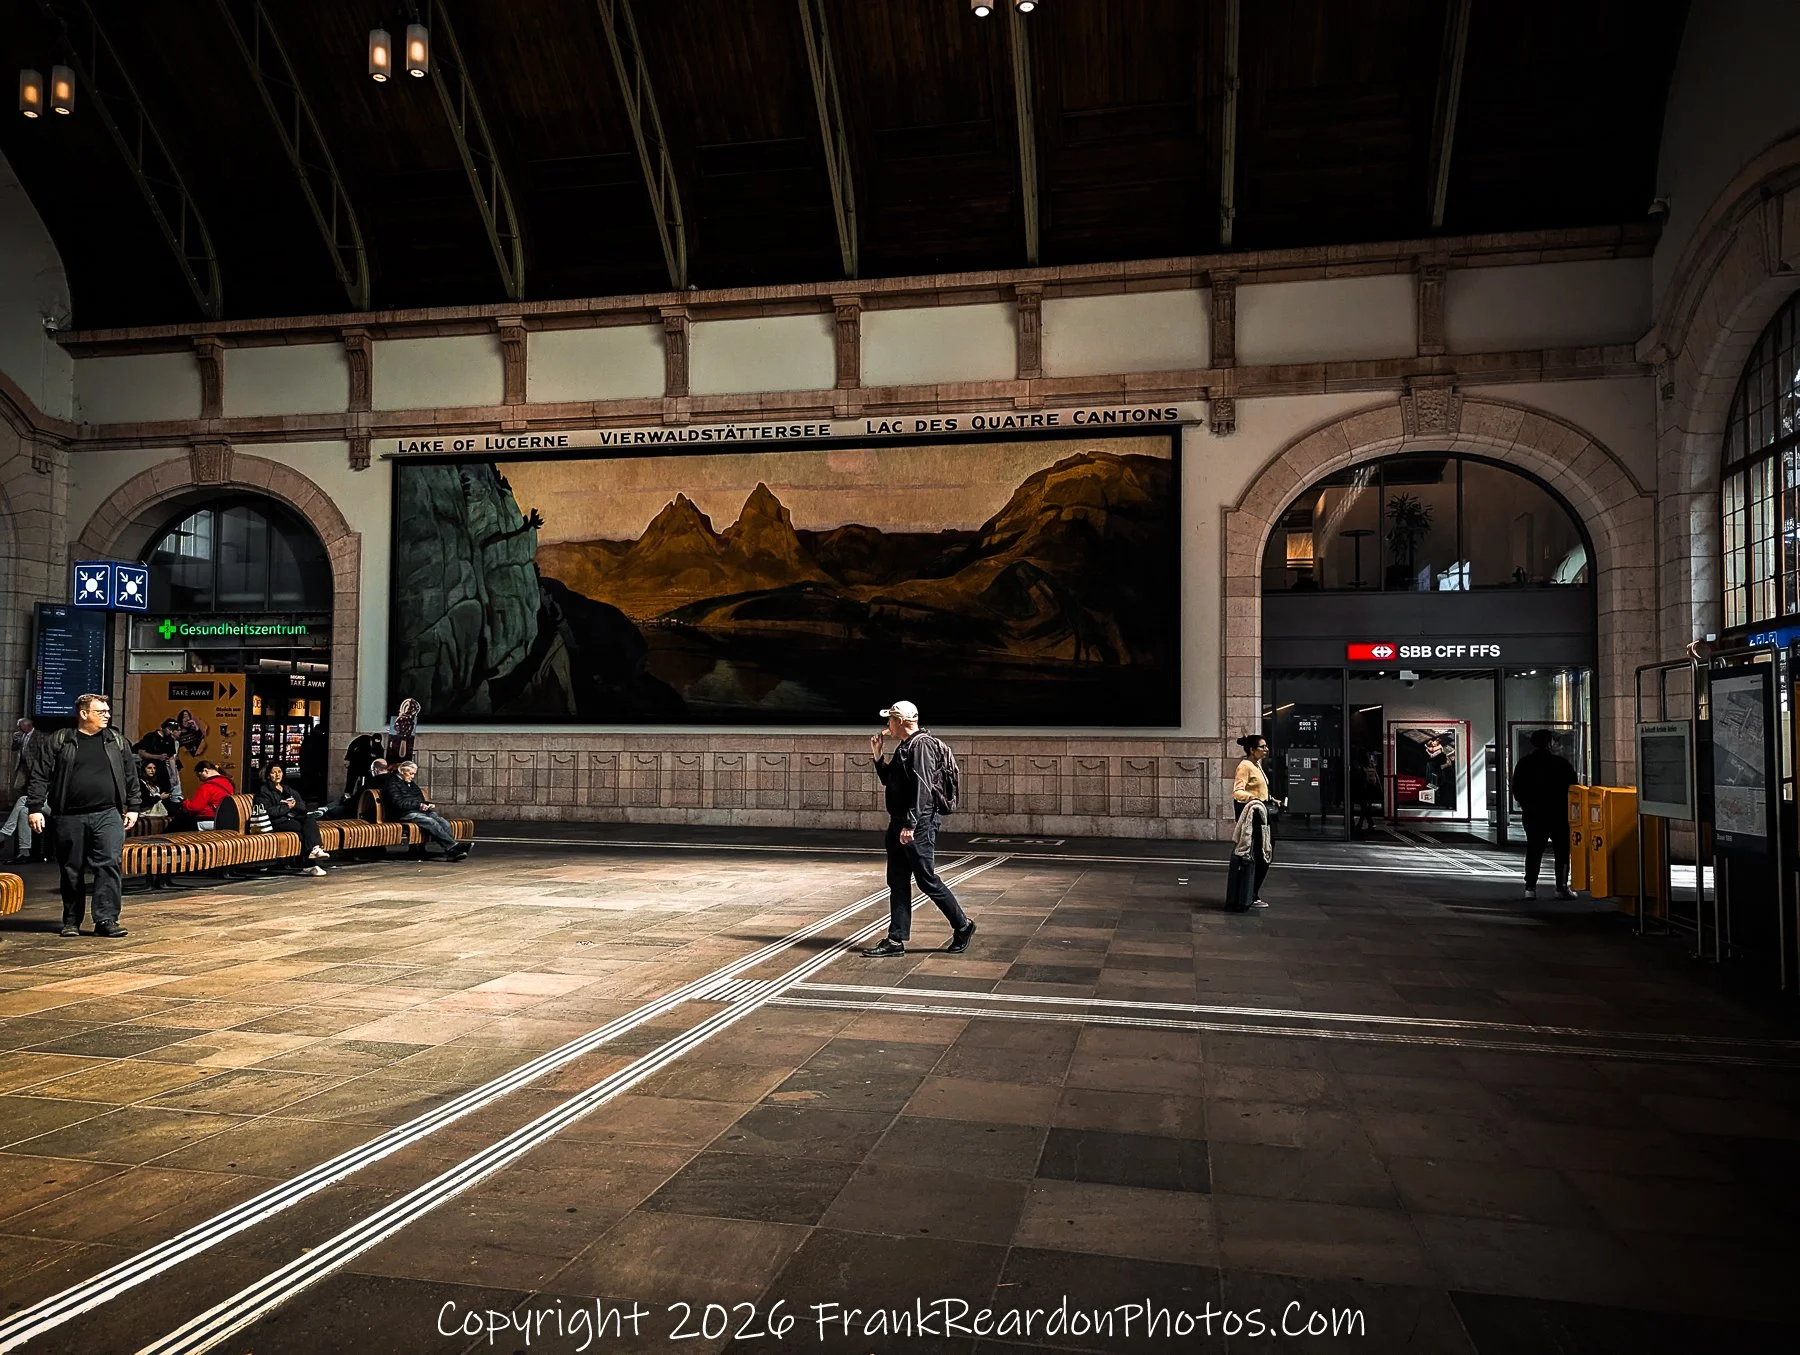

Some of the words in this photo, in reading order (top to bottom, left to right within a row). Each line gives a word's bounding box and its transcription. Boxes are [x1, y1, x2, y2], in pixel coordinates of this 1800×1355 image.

[866, 419, 904, 435] LAC
[915, 417, 958, 433] DES
[971, 412, 1060, 431] QUATRE
[1072, 407, 1179, 426] CANTONS
[398, 439, 444, 454] LAKE
[452, 438, 476, 452] OF
[484, 434, 570, 451] LUCERNE
[599, 423, 831, 446] VIERWALDSTÄTTERSEE
[1399, 645, 1432, 658] SBB
[1434, 645, 1466, 658] CFF
[1469, 644, 1501, 657] FFS
[172, 689, 189, 697] TAKE
[190, 689, 211, 697] AWAY
